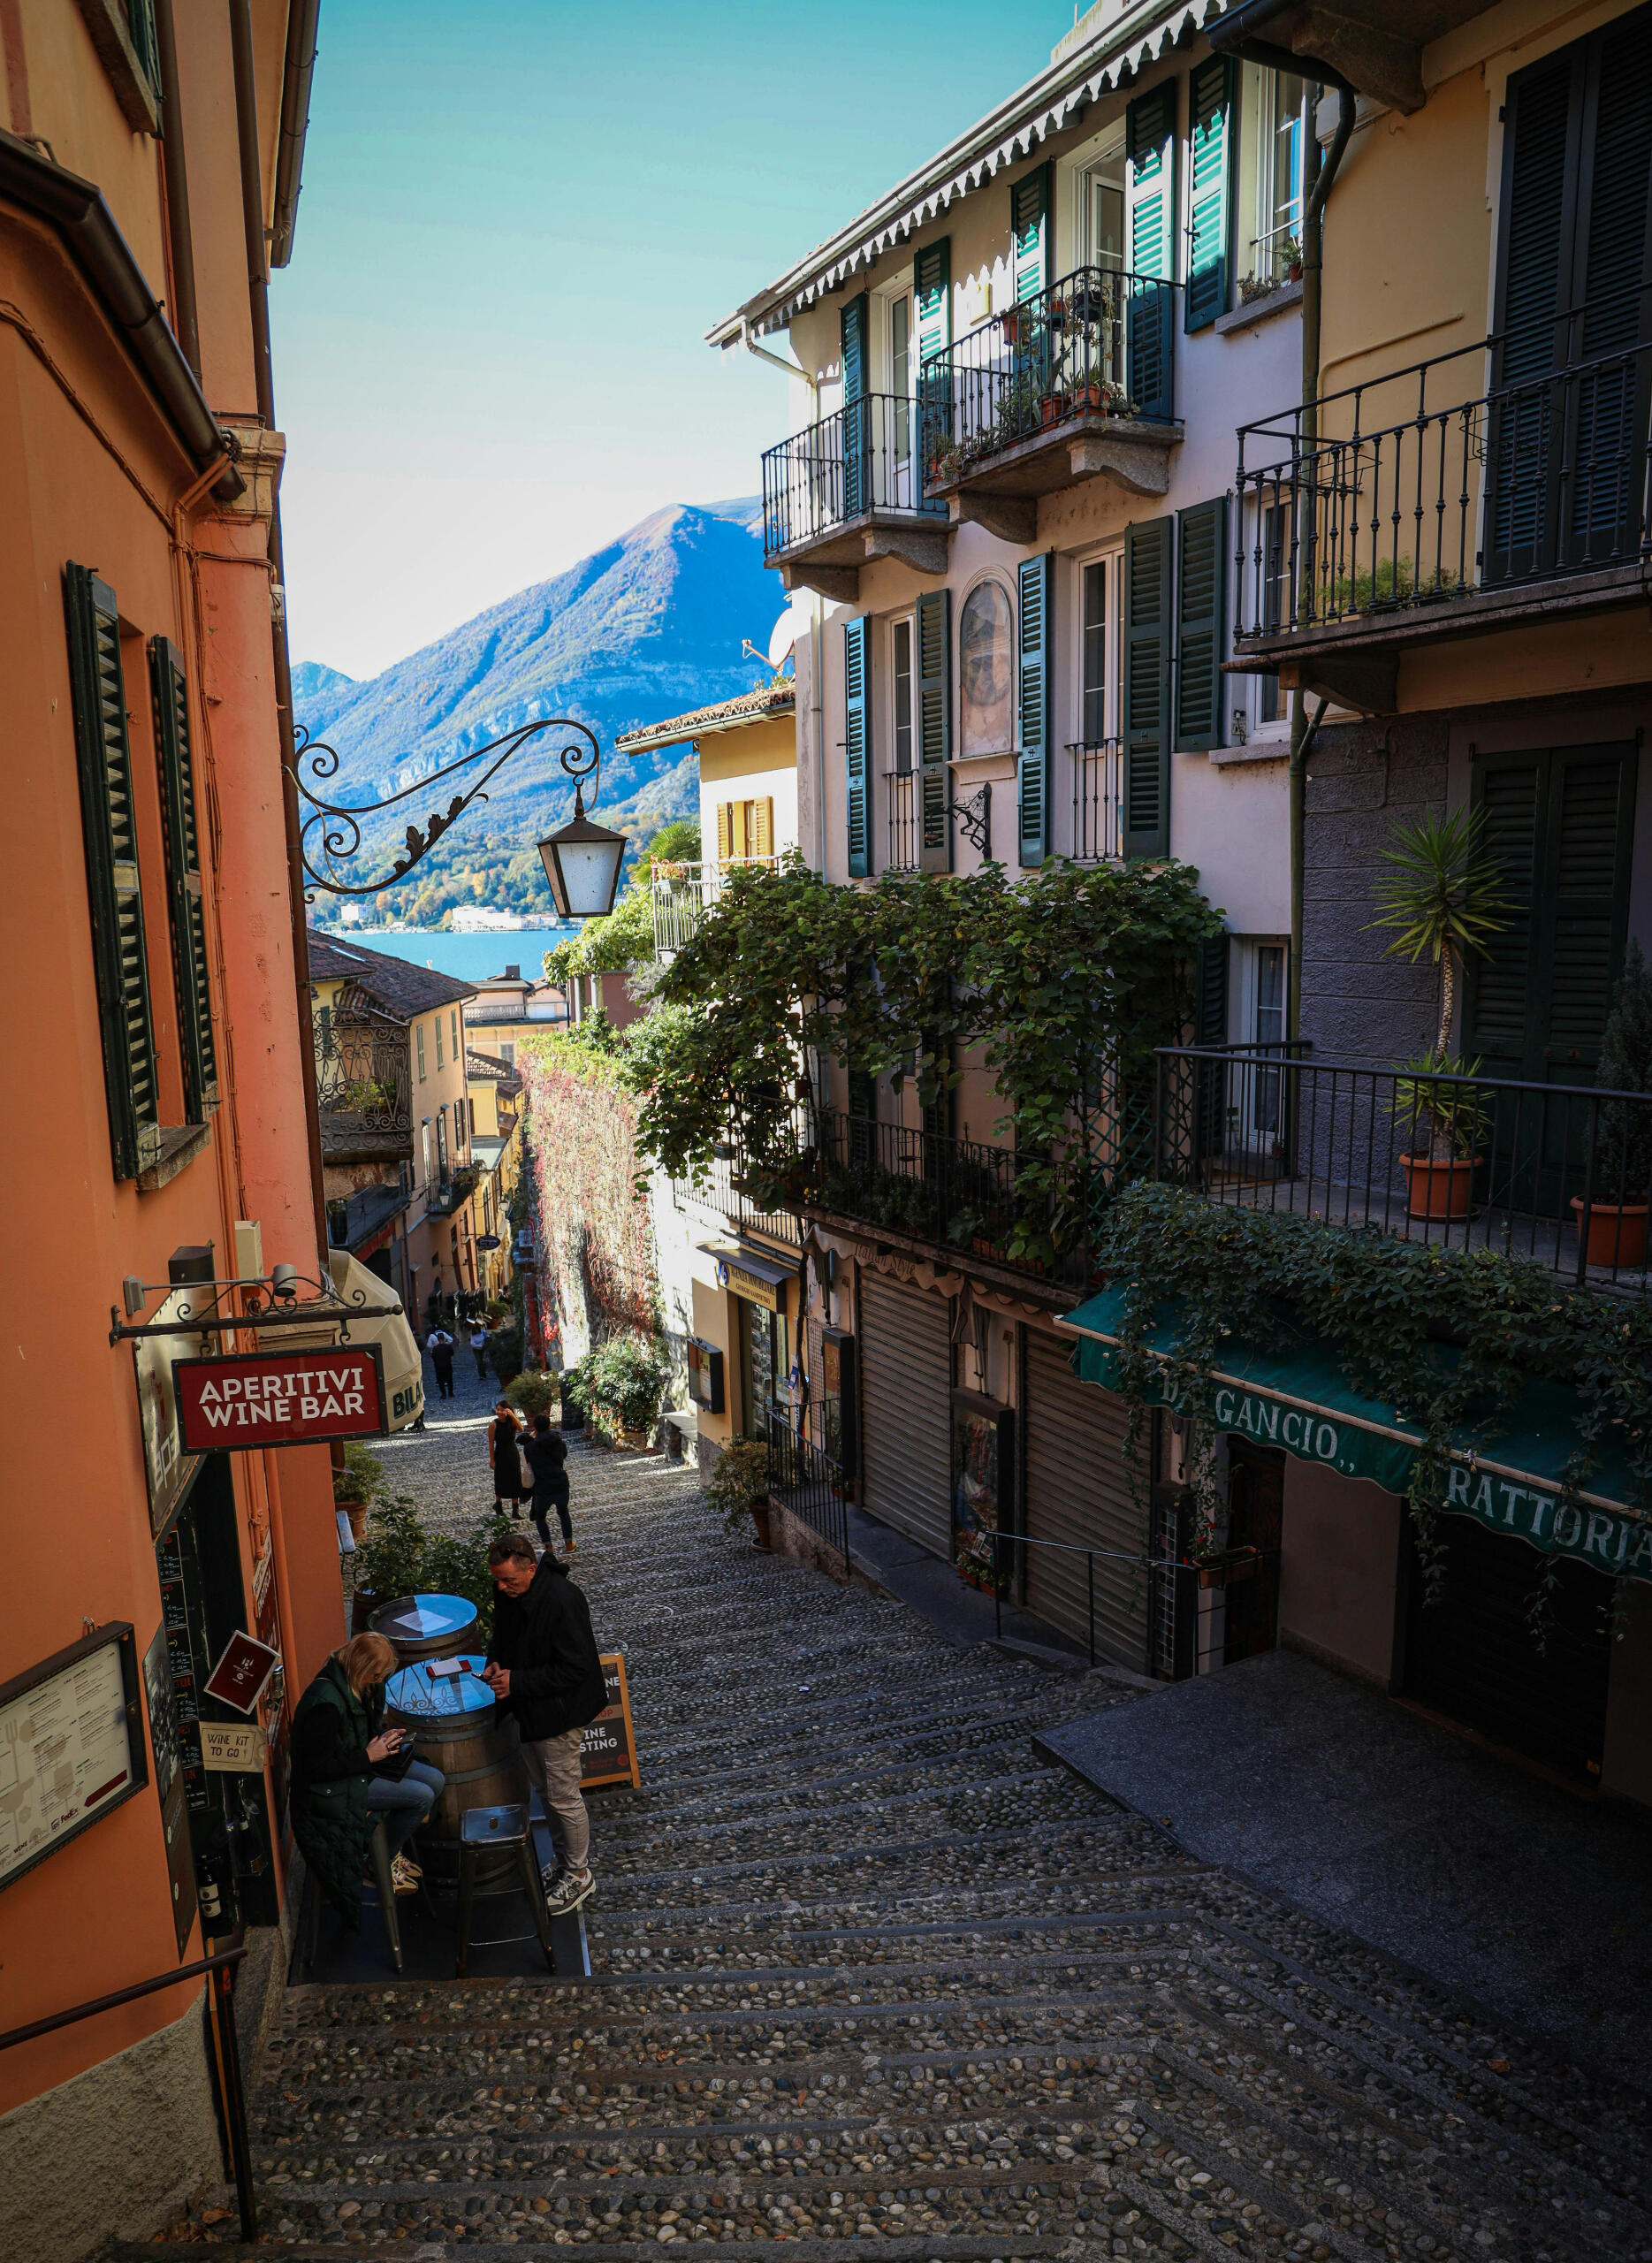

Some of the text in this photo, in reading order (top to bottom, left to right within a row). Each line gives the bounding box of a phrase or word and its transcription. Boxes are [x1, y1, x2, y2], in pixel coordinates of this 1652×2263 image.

[199, 1368, 364, 1405] APERITIVI
[393, 1380, 423, 1418] BILA
[202, 1392, 365, 1429] WINE BAR
[579, 1738, 618, 1753] STING
[584, 1727, 605, 1741] INE
[210, 1746, 240, 1758] TO GO
